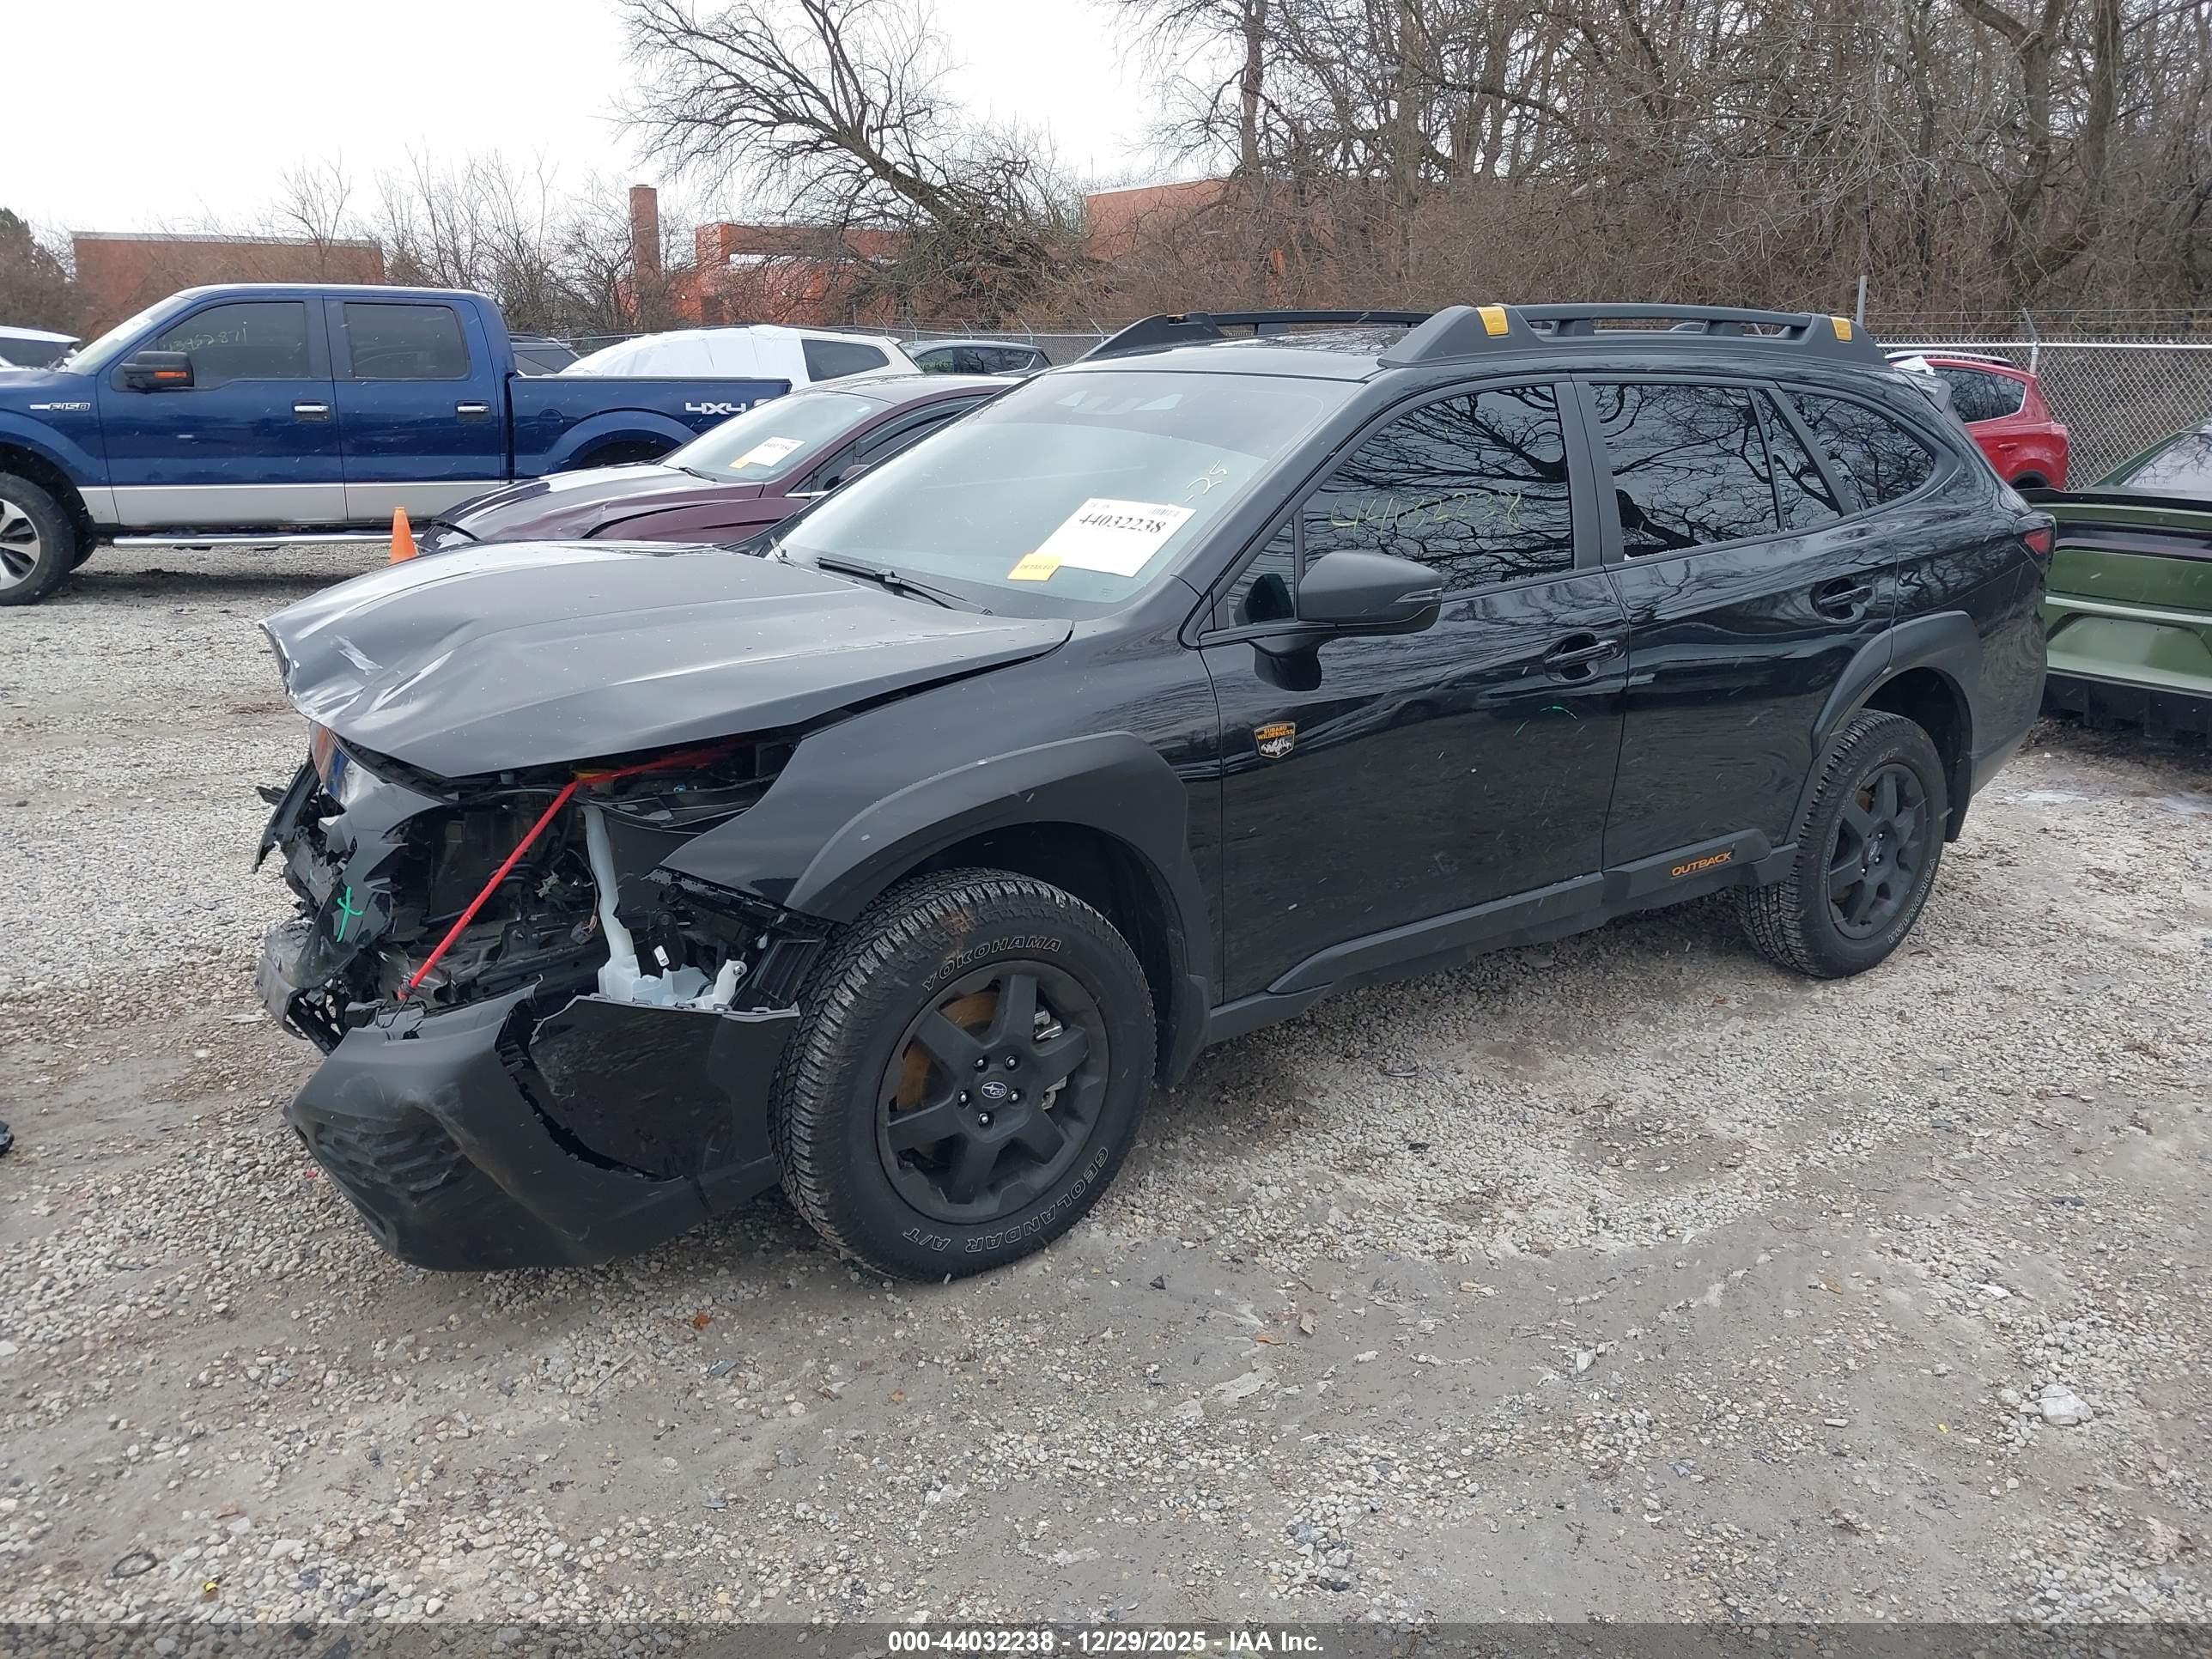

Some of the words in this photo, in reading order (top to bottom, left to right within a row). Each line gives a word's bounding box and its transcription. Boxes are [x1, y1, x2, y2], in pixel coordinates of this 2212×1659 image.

[1079, 513, 1167, 534] 44032238
[1257, 729, 1294, 740] WILDERNESS
[1671, 851, 1732, 877] OUTBACK
[921, 935, 1063, 993] YOKOHAMA
[964, 1146, 1109, 1254] GEOLANDAR
[902, 1227, 951, 1252] A/T
